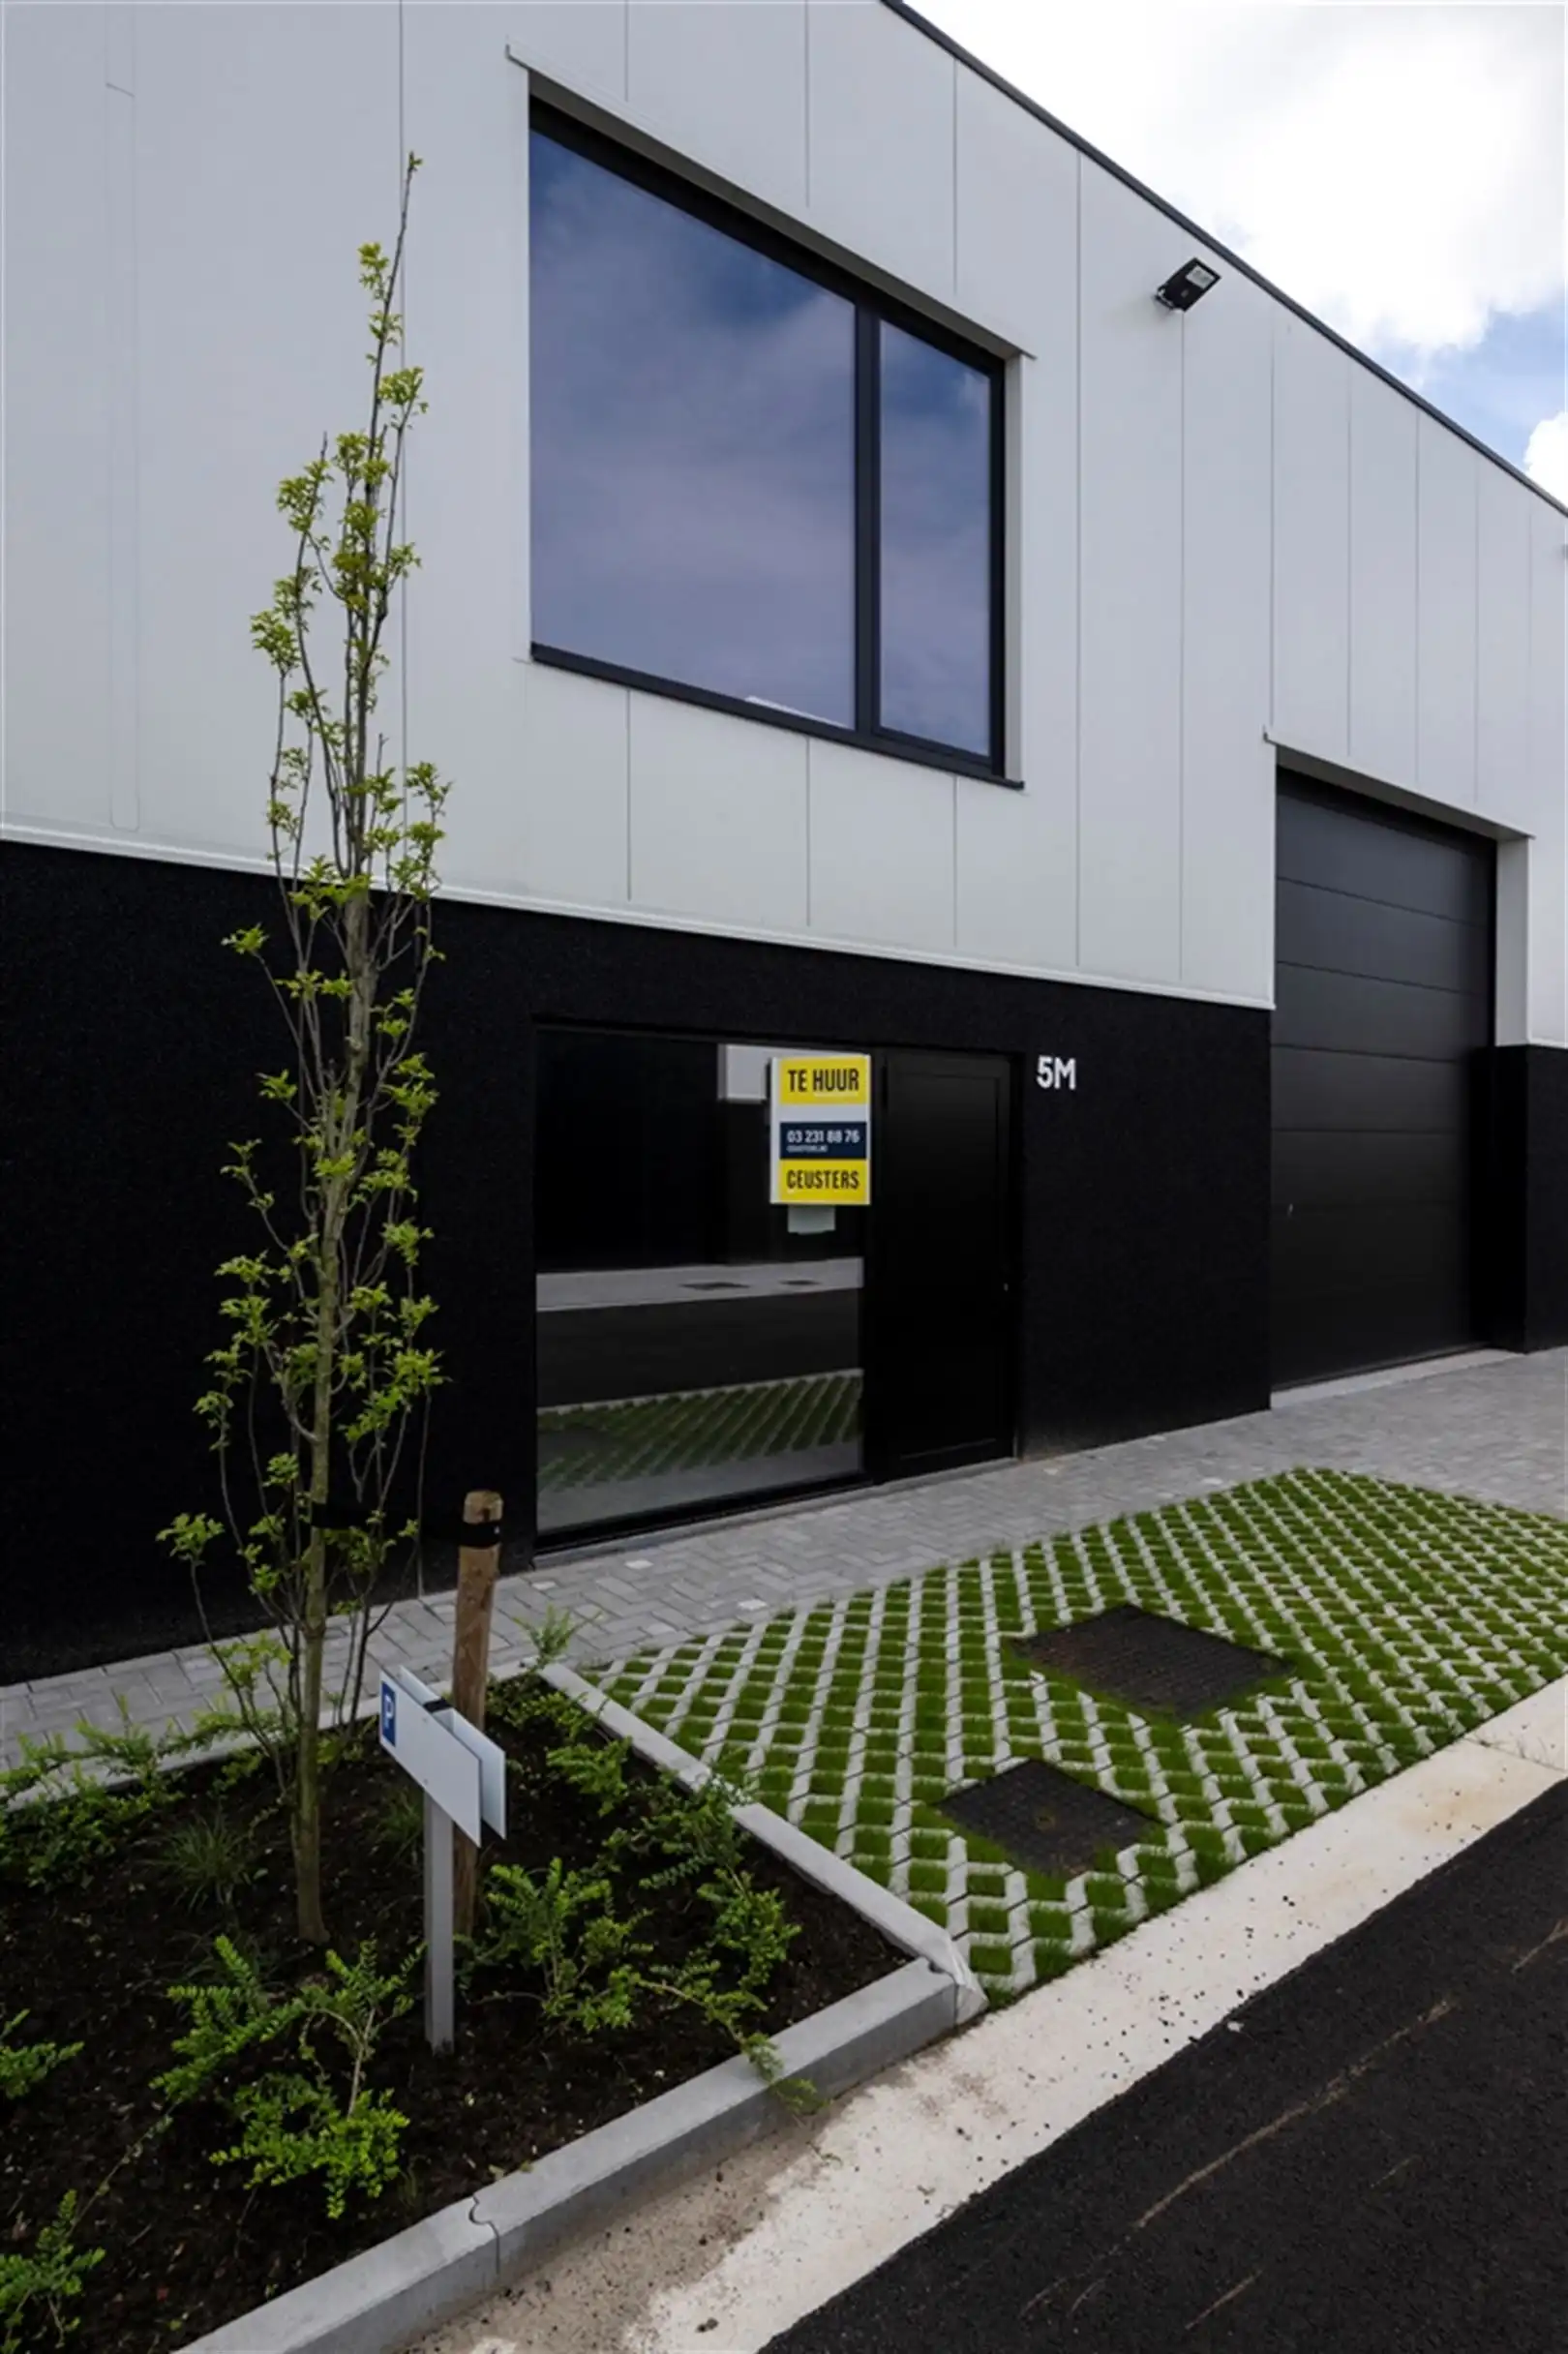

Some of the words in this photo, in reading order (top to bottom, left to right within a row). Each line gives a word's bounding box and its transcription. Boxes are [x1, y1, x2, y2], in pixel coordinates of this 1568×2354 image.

[788, 1070, 807, 1093] TE
[812, 1068, 859, 1092] HUUR
[1037, 1055, 1076, 1091] 5M
[786, 1130, 802, 1143] 03
[804, 1130, 825, 1143] 231
[787, 1169, 859, 1190] CEUSTERS
[383, 1693, 394, 1729] P
